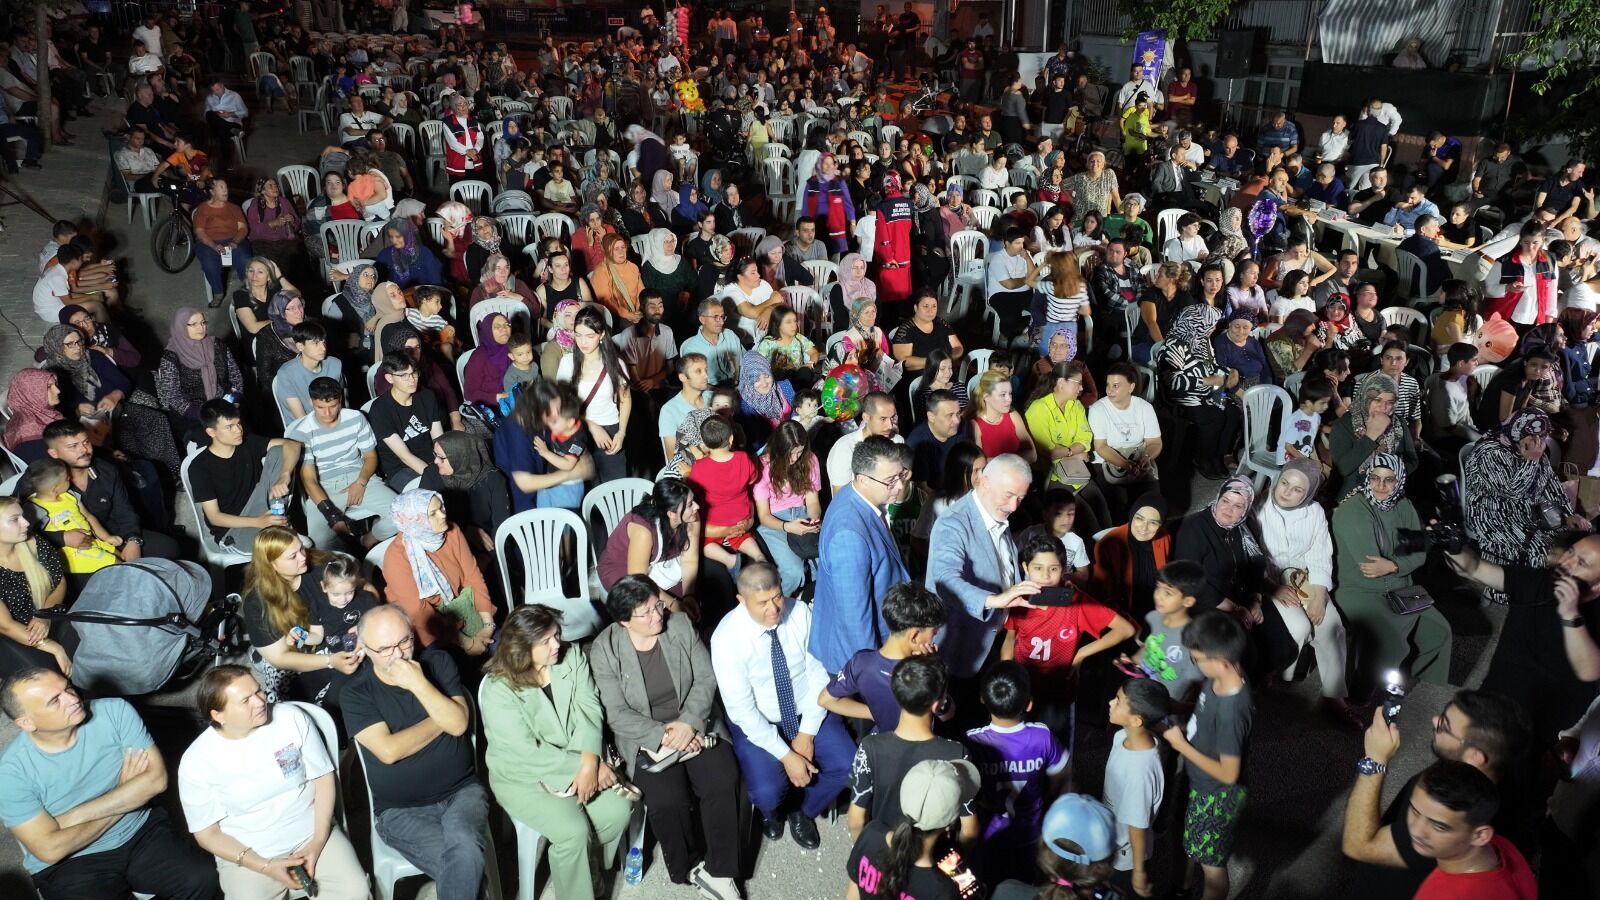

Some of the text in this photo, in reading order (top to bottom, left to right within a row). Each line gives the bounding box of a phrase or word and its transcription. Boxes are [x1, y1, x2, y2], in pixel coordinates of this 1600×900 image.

[1029, 636, 1051, 661] 21
[982, 757, 1043, 775] RONALDO
[996, 780, 1027, 819] 7
